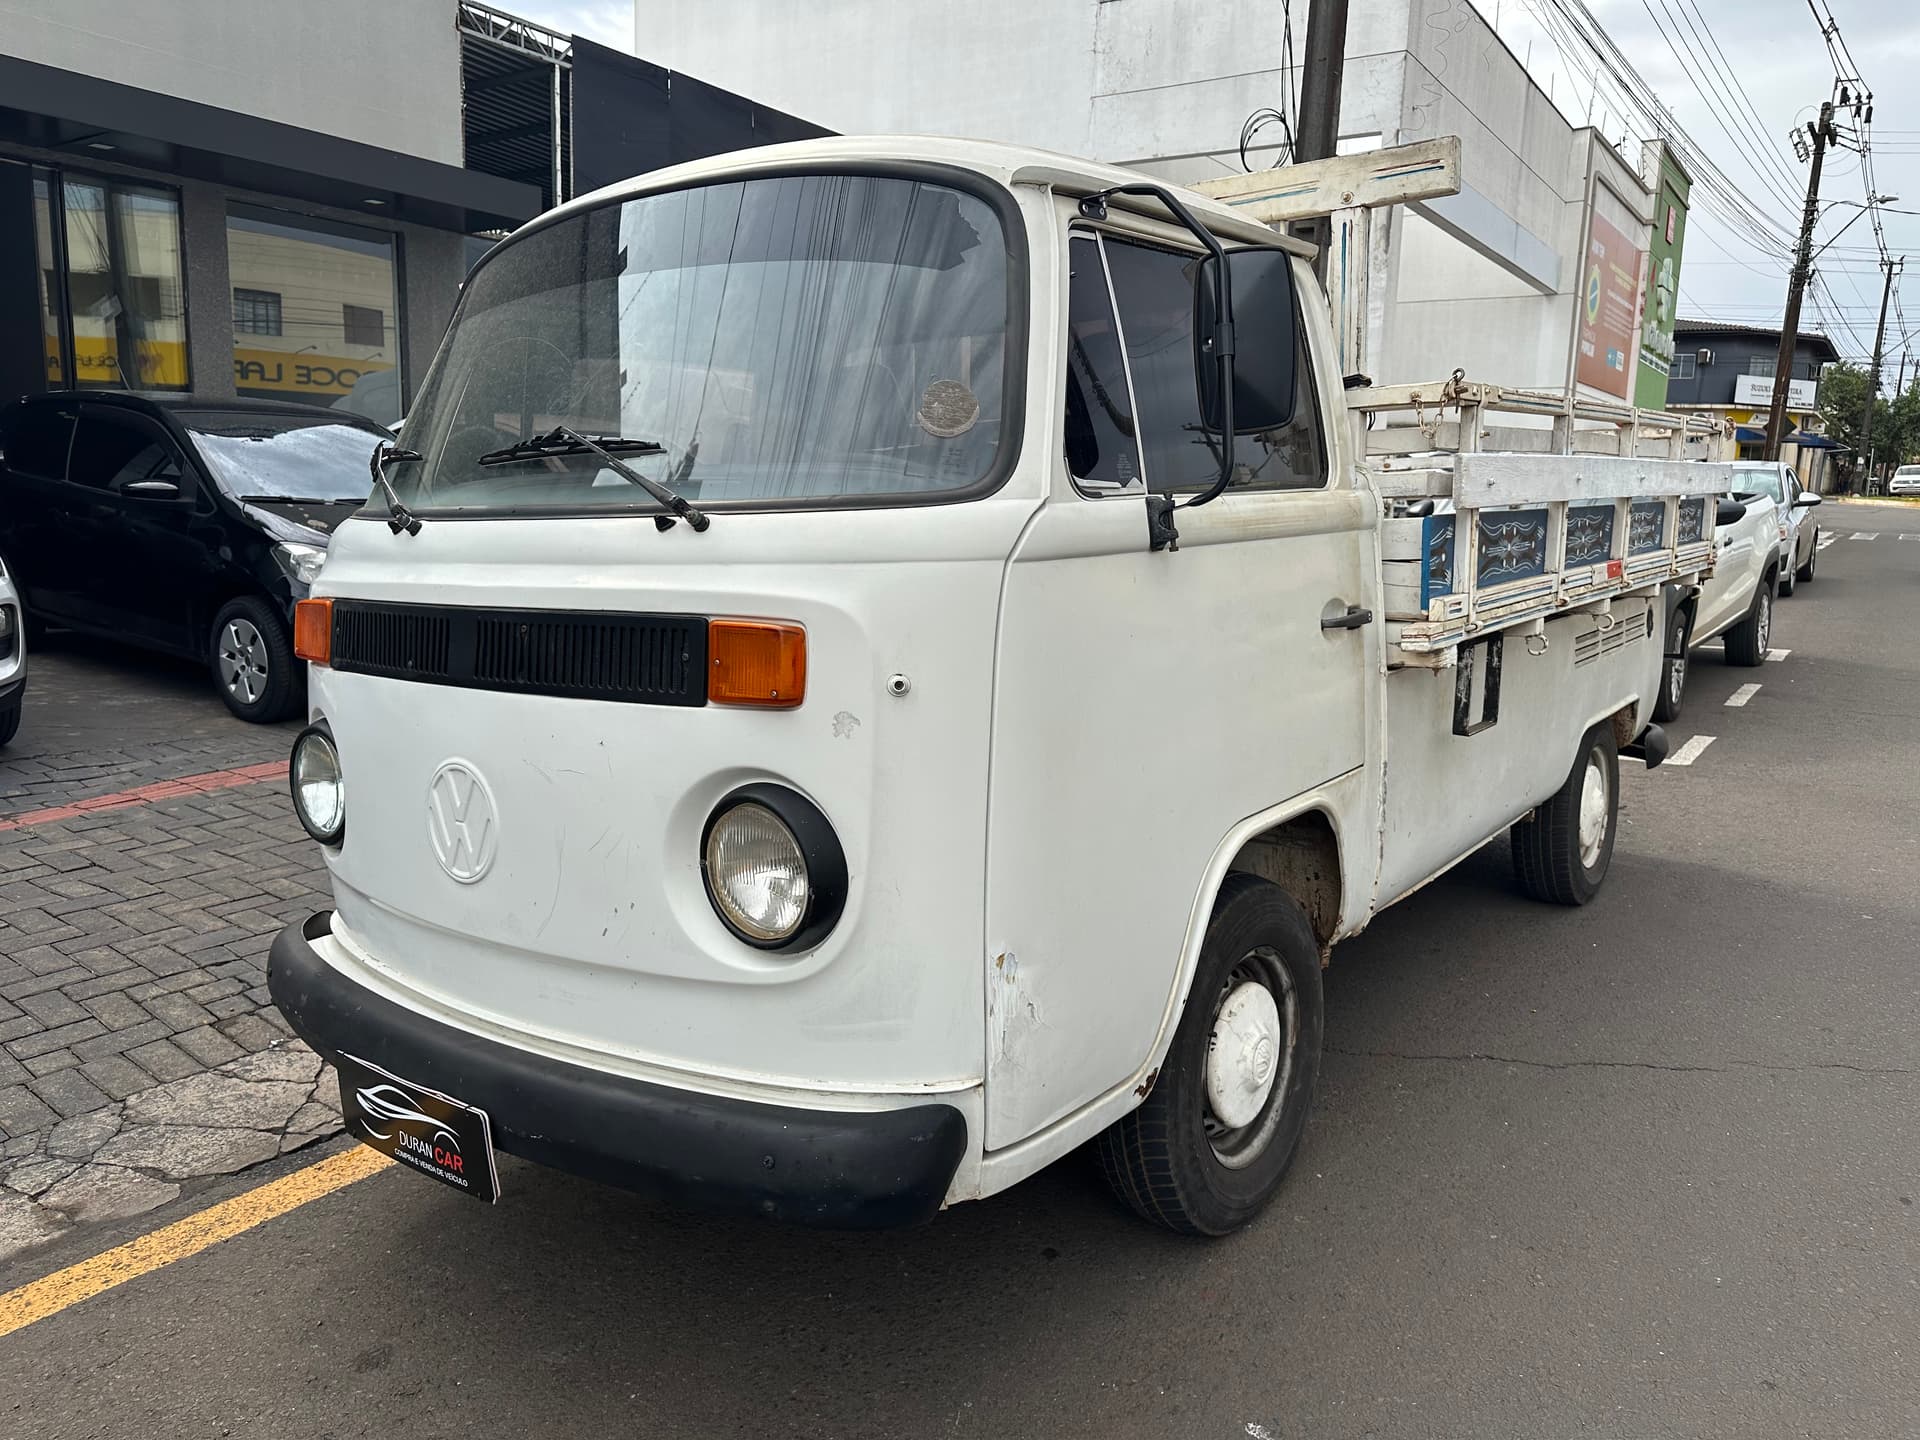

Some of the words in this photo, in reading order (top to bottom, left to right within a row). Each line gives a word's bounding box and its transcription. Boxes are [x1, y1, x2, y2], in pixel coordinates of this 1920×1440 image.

[430, 764, 495, 881] VW
[399, 1130, 433, 1159] DURAN
[434, 1146, 464, 1174] CAR
[436, 1167, 445, 1177] DE
